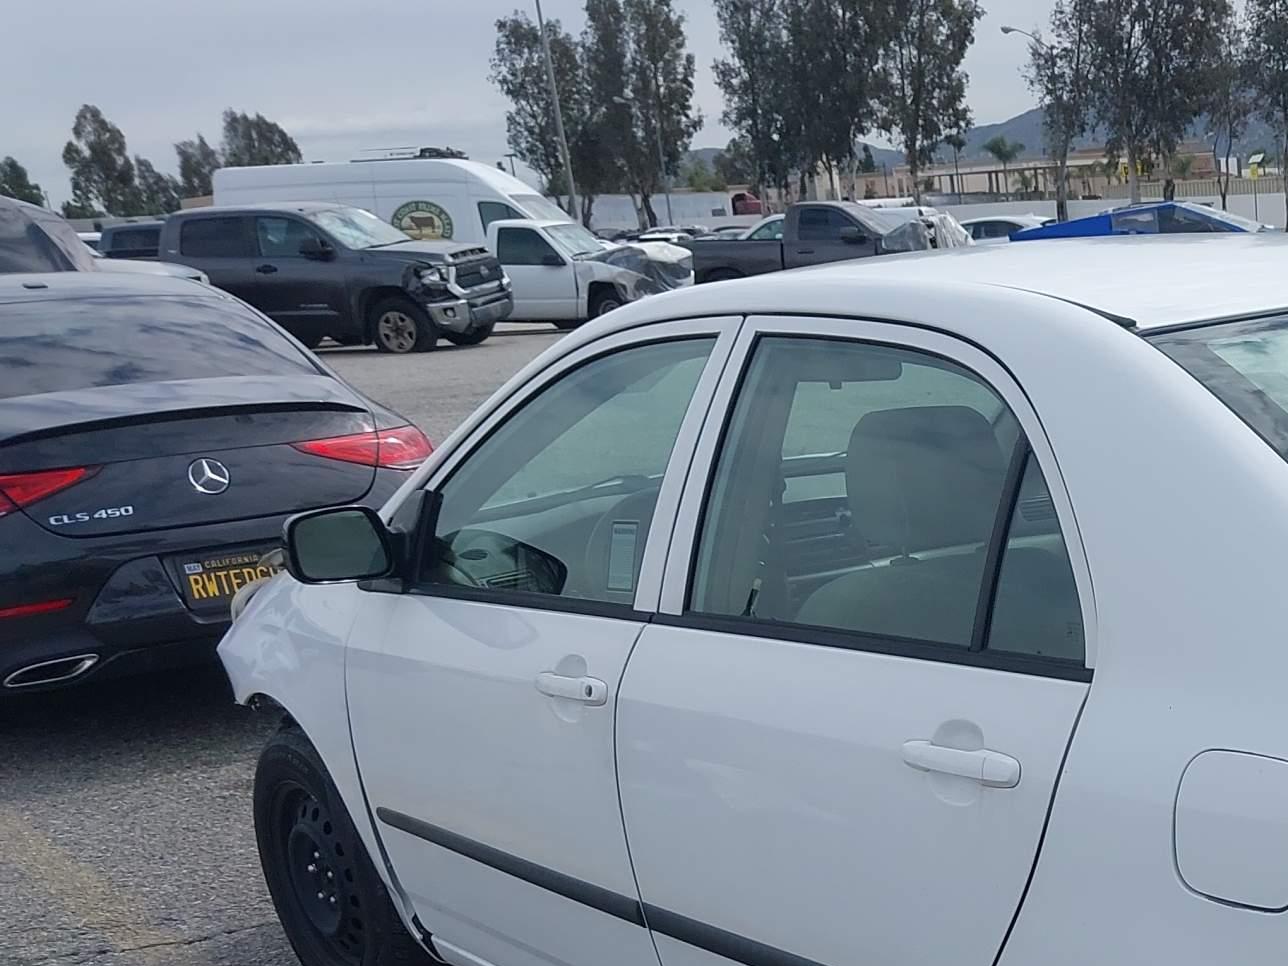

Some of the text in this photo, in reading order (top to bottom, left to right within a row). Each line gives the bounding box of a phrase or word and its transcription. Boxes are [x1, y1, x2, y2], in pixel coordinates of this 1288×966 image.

[48, 505, 134, 525] CLS 450
[204, 554, 259, 569] CALIFORNIA
